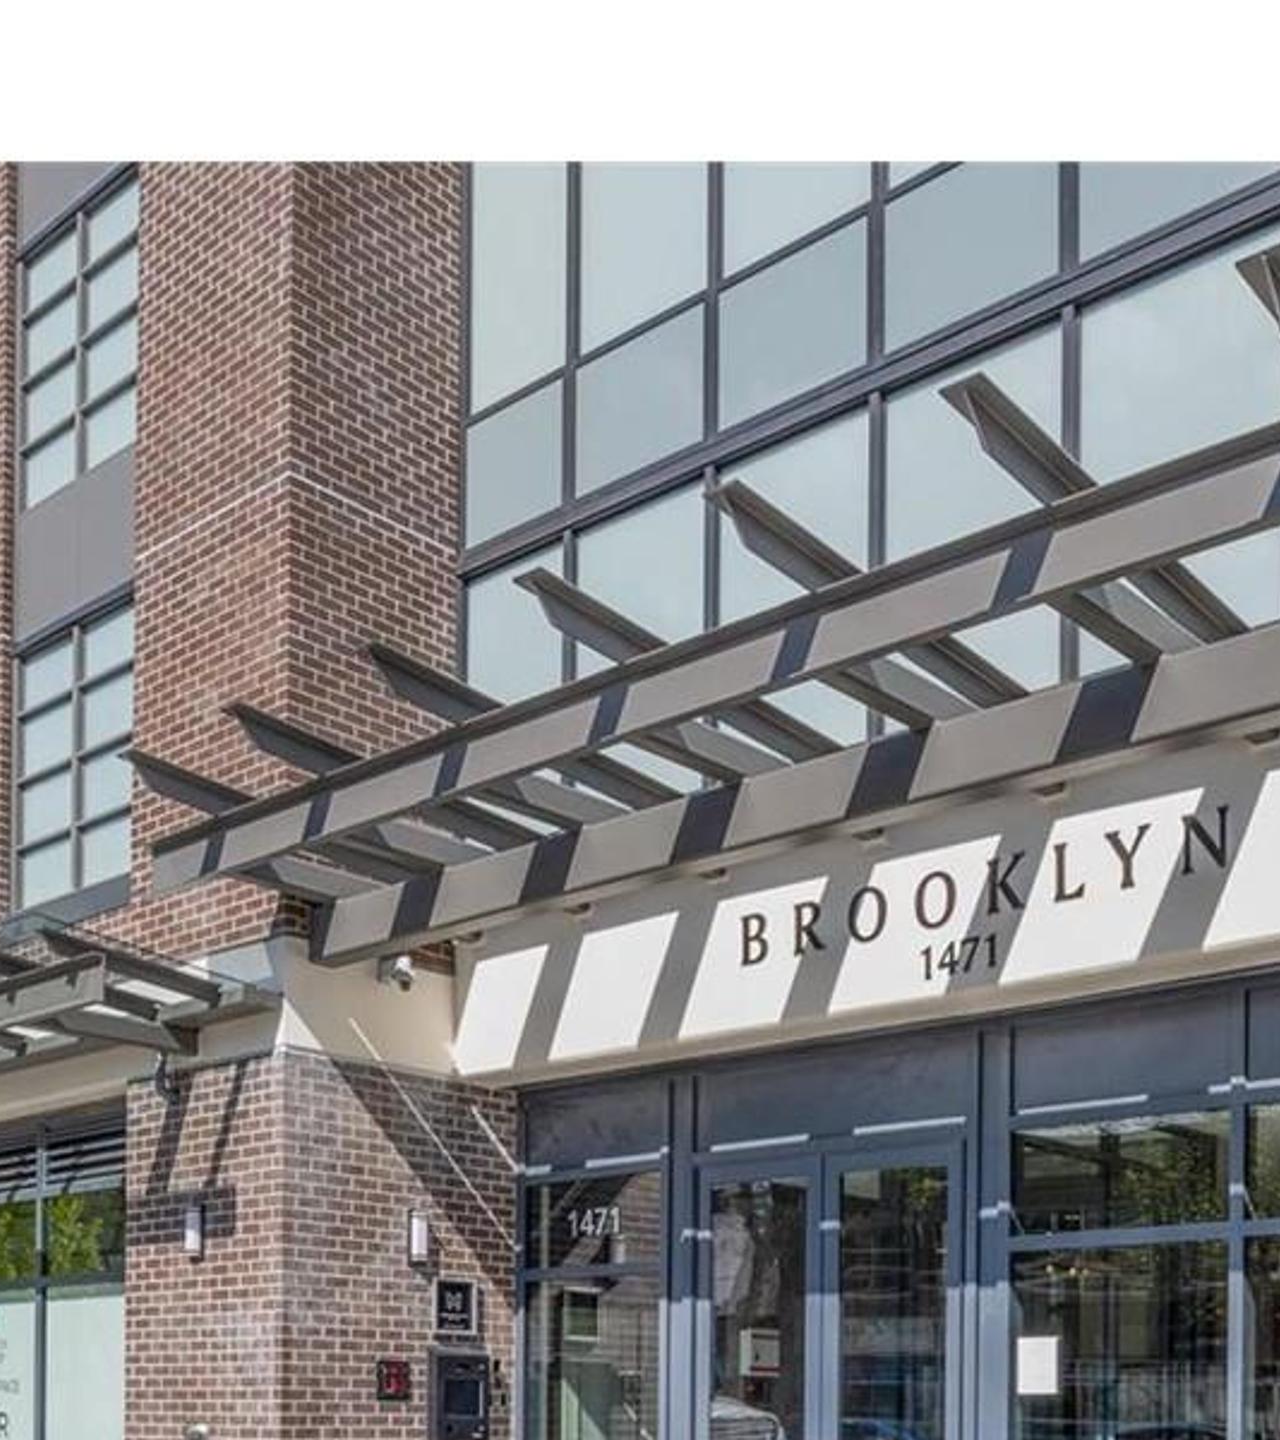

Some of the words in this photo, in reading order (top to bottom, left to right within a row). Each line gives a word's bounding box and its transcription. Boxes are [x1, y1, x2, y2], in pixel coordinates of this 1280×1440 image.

[739, 806, 1231, 967] BROOKLYN
[920, 933, 999, 981] 1471
[567, 1206, 620, 1238] 1471
